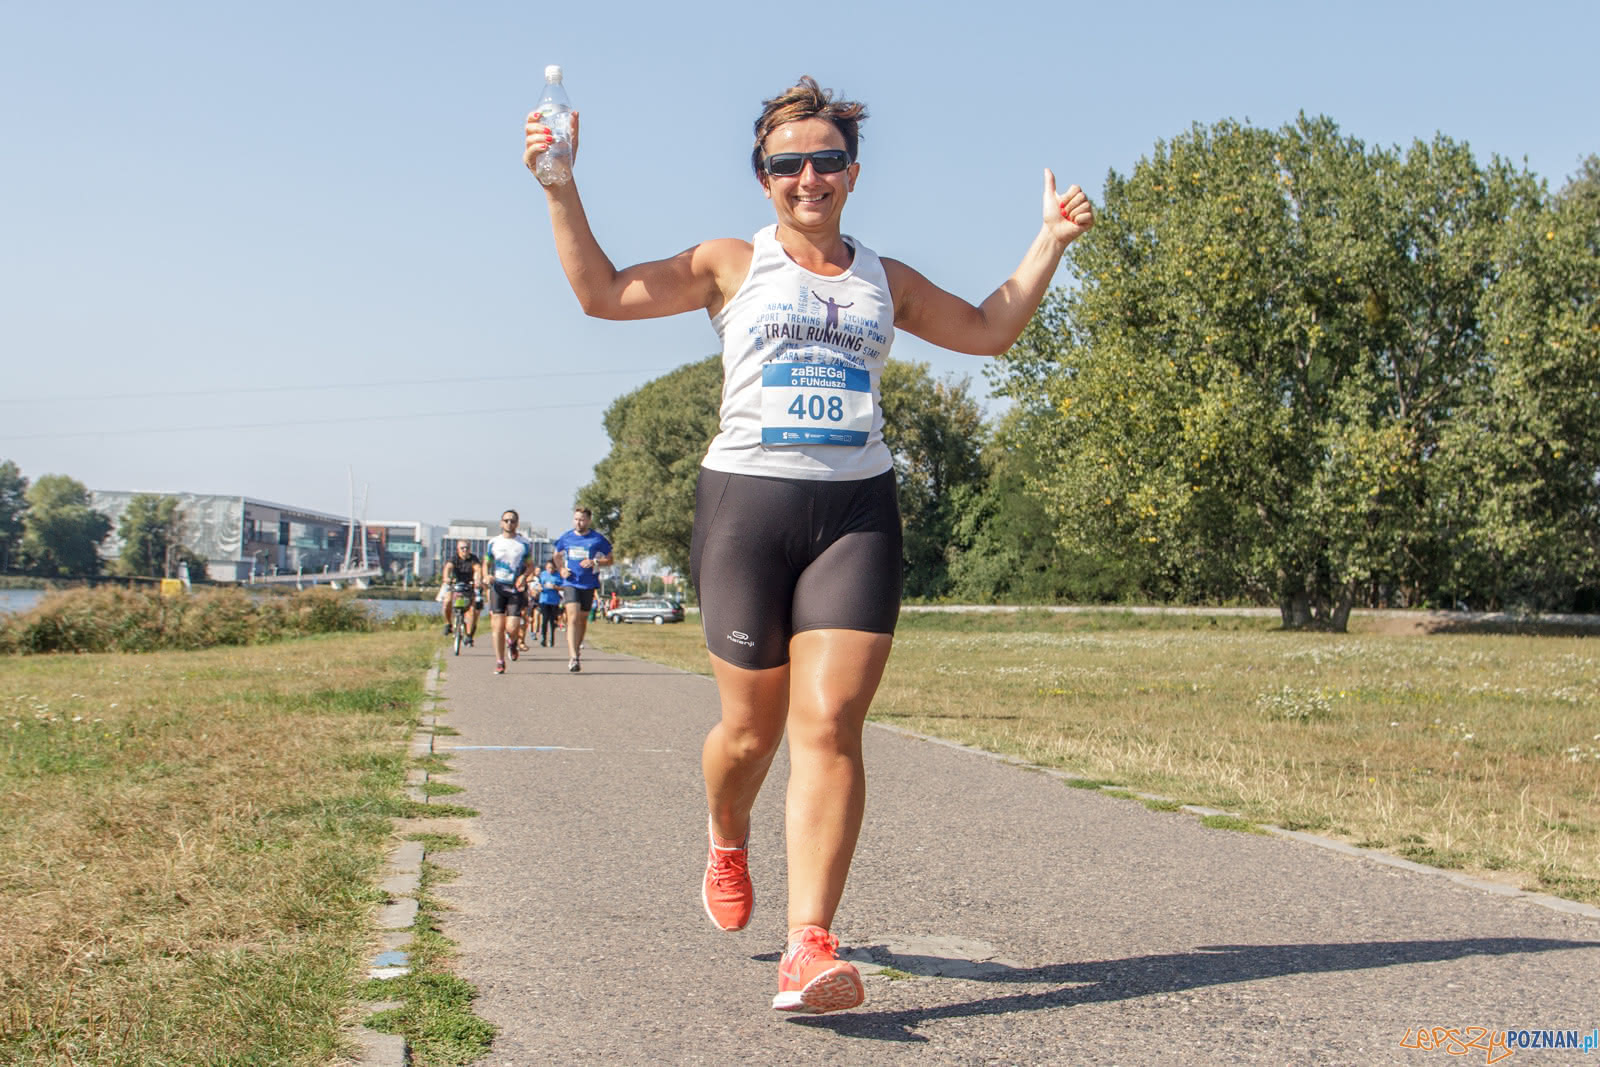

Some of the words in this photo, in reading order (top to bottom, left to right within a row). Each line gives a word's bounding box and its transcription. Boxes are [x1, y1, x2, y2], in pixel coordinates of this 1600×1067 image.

[787, 313, 821, 327] TRENING
[764, 323, 803, 341] TRAIL
[806, 326, 864, 352] RUNNING
[844, 322, 863, 336] META
[867, 329, 887, 344] POWER
[863, 346, 880, 360] START
[791, 366, 846, 382] zaBIEGaj
[800, 377, 846, 389] FUNdusze
[787, 394, 844, 422] 408
